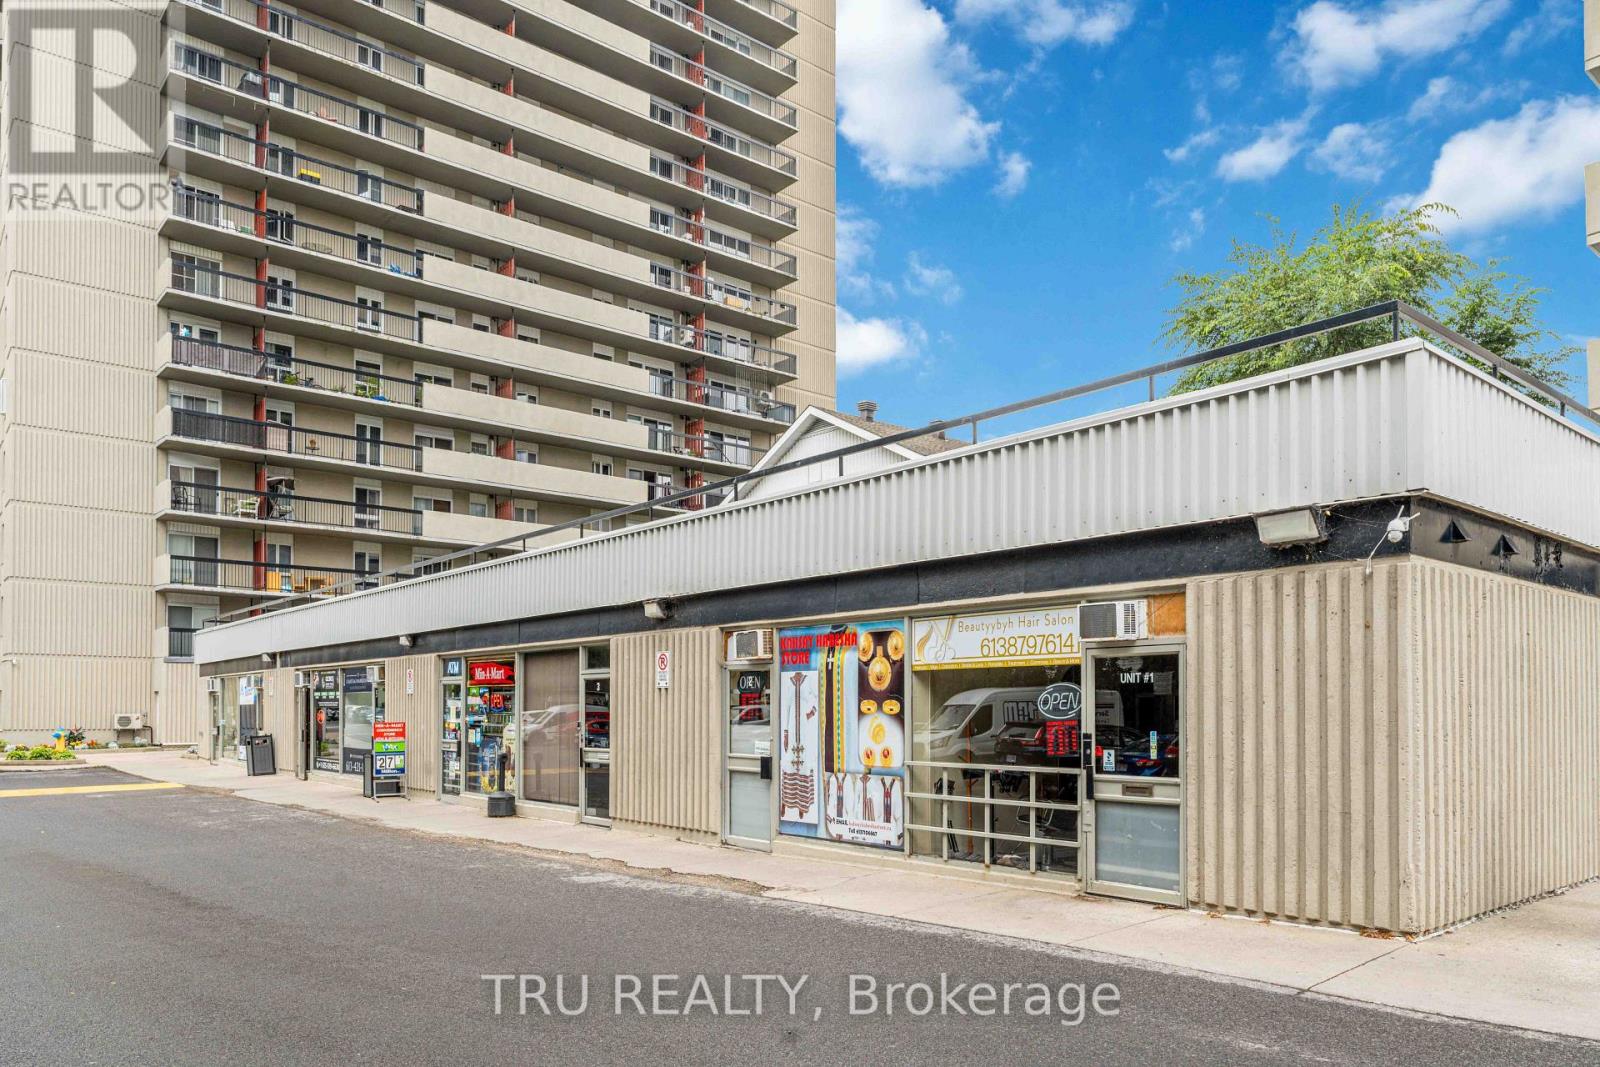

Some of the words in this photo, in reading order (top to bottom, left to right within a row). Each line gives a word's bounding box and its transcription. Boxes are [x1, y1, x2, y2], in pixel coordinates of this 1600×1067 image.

[958, 619, 1014, 634] Beautyybyh
[1018, 616, 1040, 629] Hair
[1044, 613, 1074, 626] Salon
[816, 633, 858, 648] HABESHA
[980, 633, 1075, 657] 6138797614
[781, 651, 810, 666] STORE
[447, 661, 460, 674] ATM
[474, 667, 505, 680] Min-A-Mart
[739, 675, 761, 689] OPEN
[1120, 672, 1142, 684] UNIT
[1143, 672, 1154, 684] #1
[1040, 692, 1080, 710] OPEN
